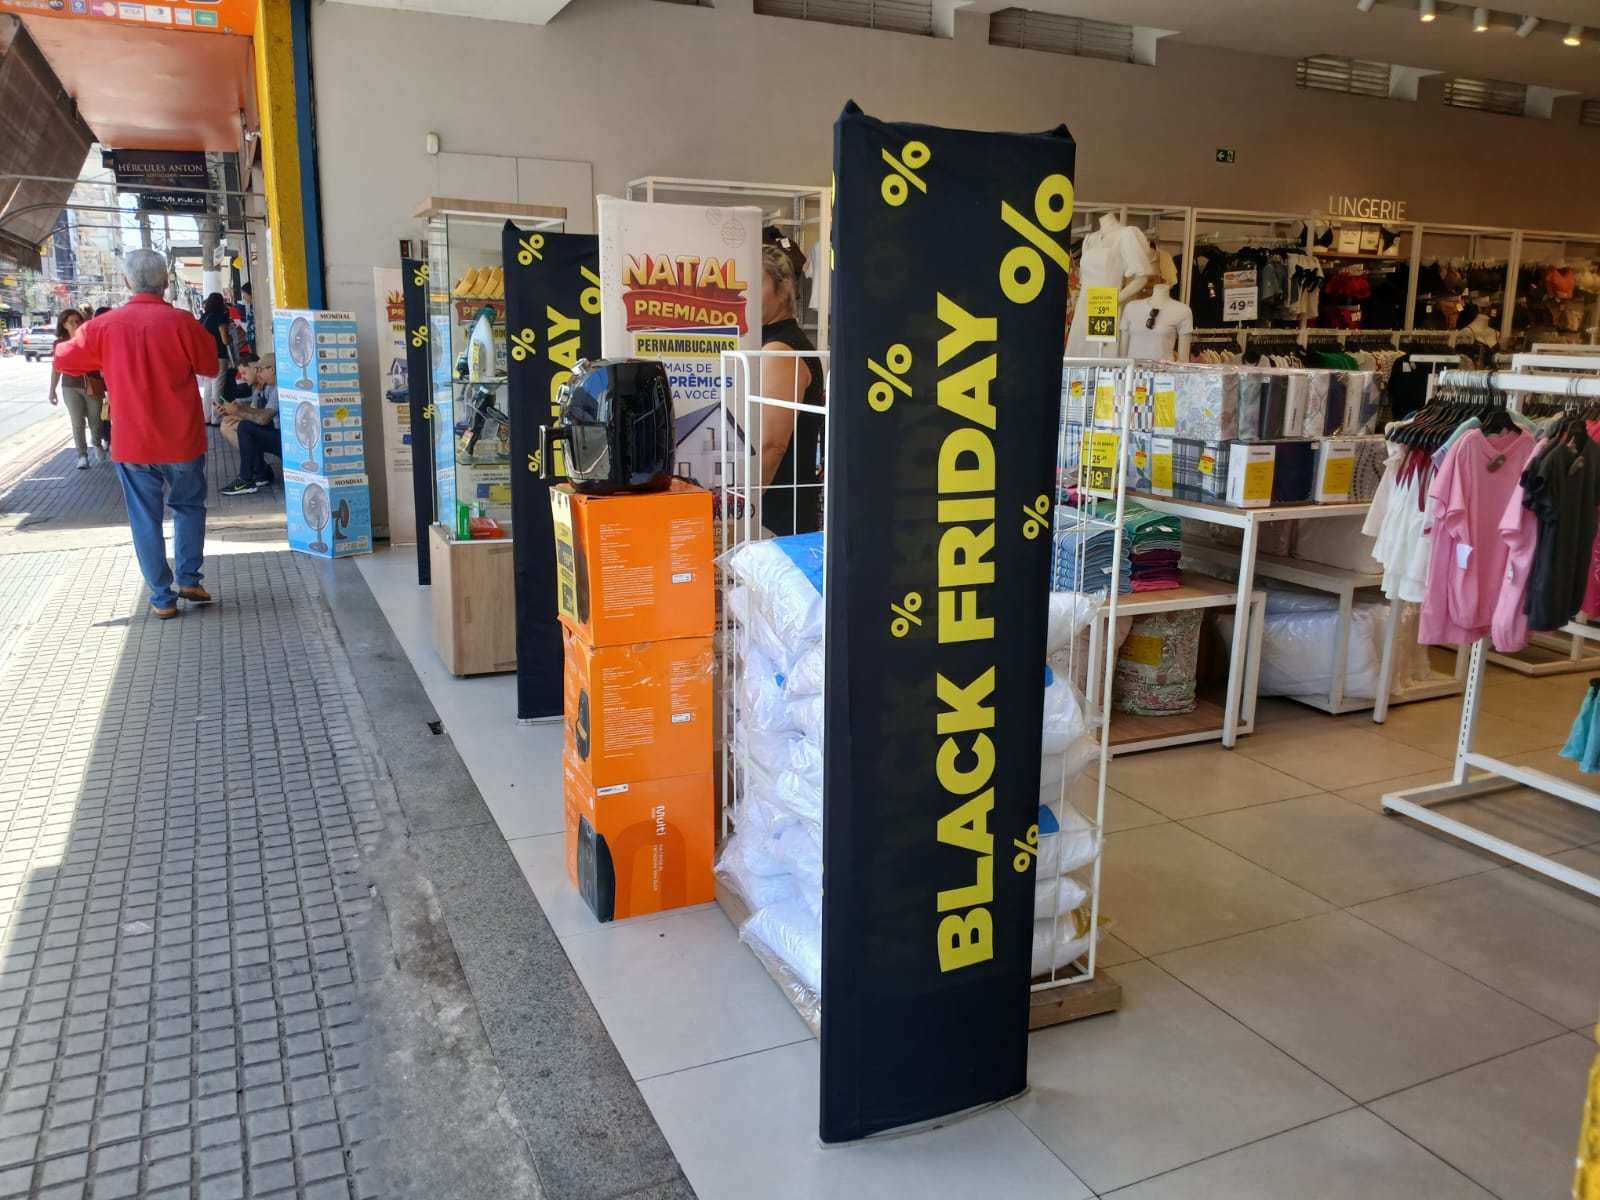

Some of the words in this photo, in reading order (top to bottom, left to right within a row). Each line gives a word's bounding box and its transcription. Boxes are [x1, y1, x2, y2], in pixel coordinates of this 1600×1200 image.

[169, 163, 203, 173] ANTON
[1328, 194, 1407, 220] LINGERIE
[622, 254, 748, 290] NATAL
[634, 299, 738, 326] PREMIADO
[637, 338, 735, 354] PERNAMBUCANAS
[664, 363, 693, 373] MAIS
[696, 363, 713, 373] DE
[936, 291, 998, 644] FRIDAY
[335, 479, 363, 487] MONDIAL
[655, 805, 667, 836] Multi
[936, 665, 996, 973] BLACK
